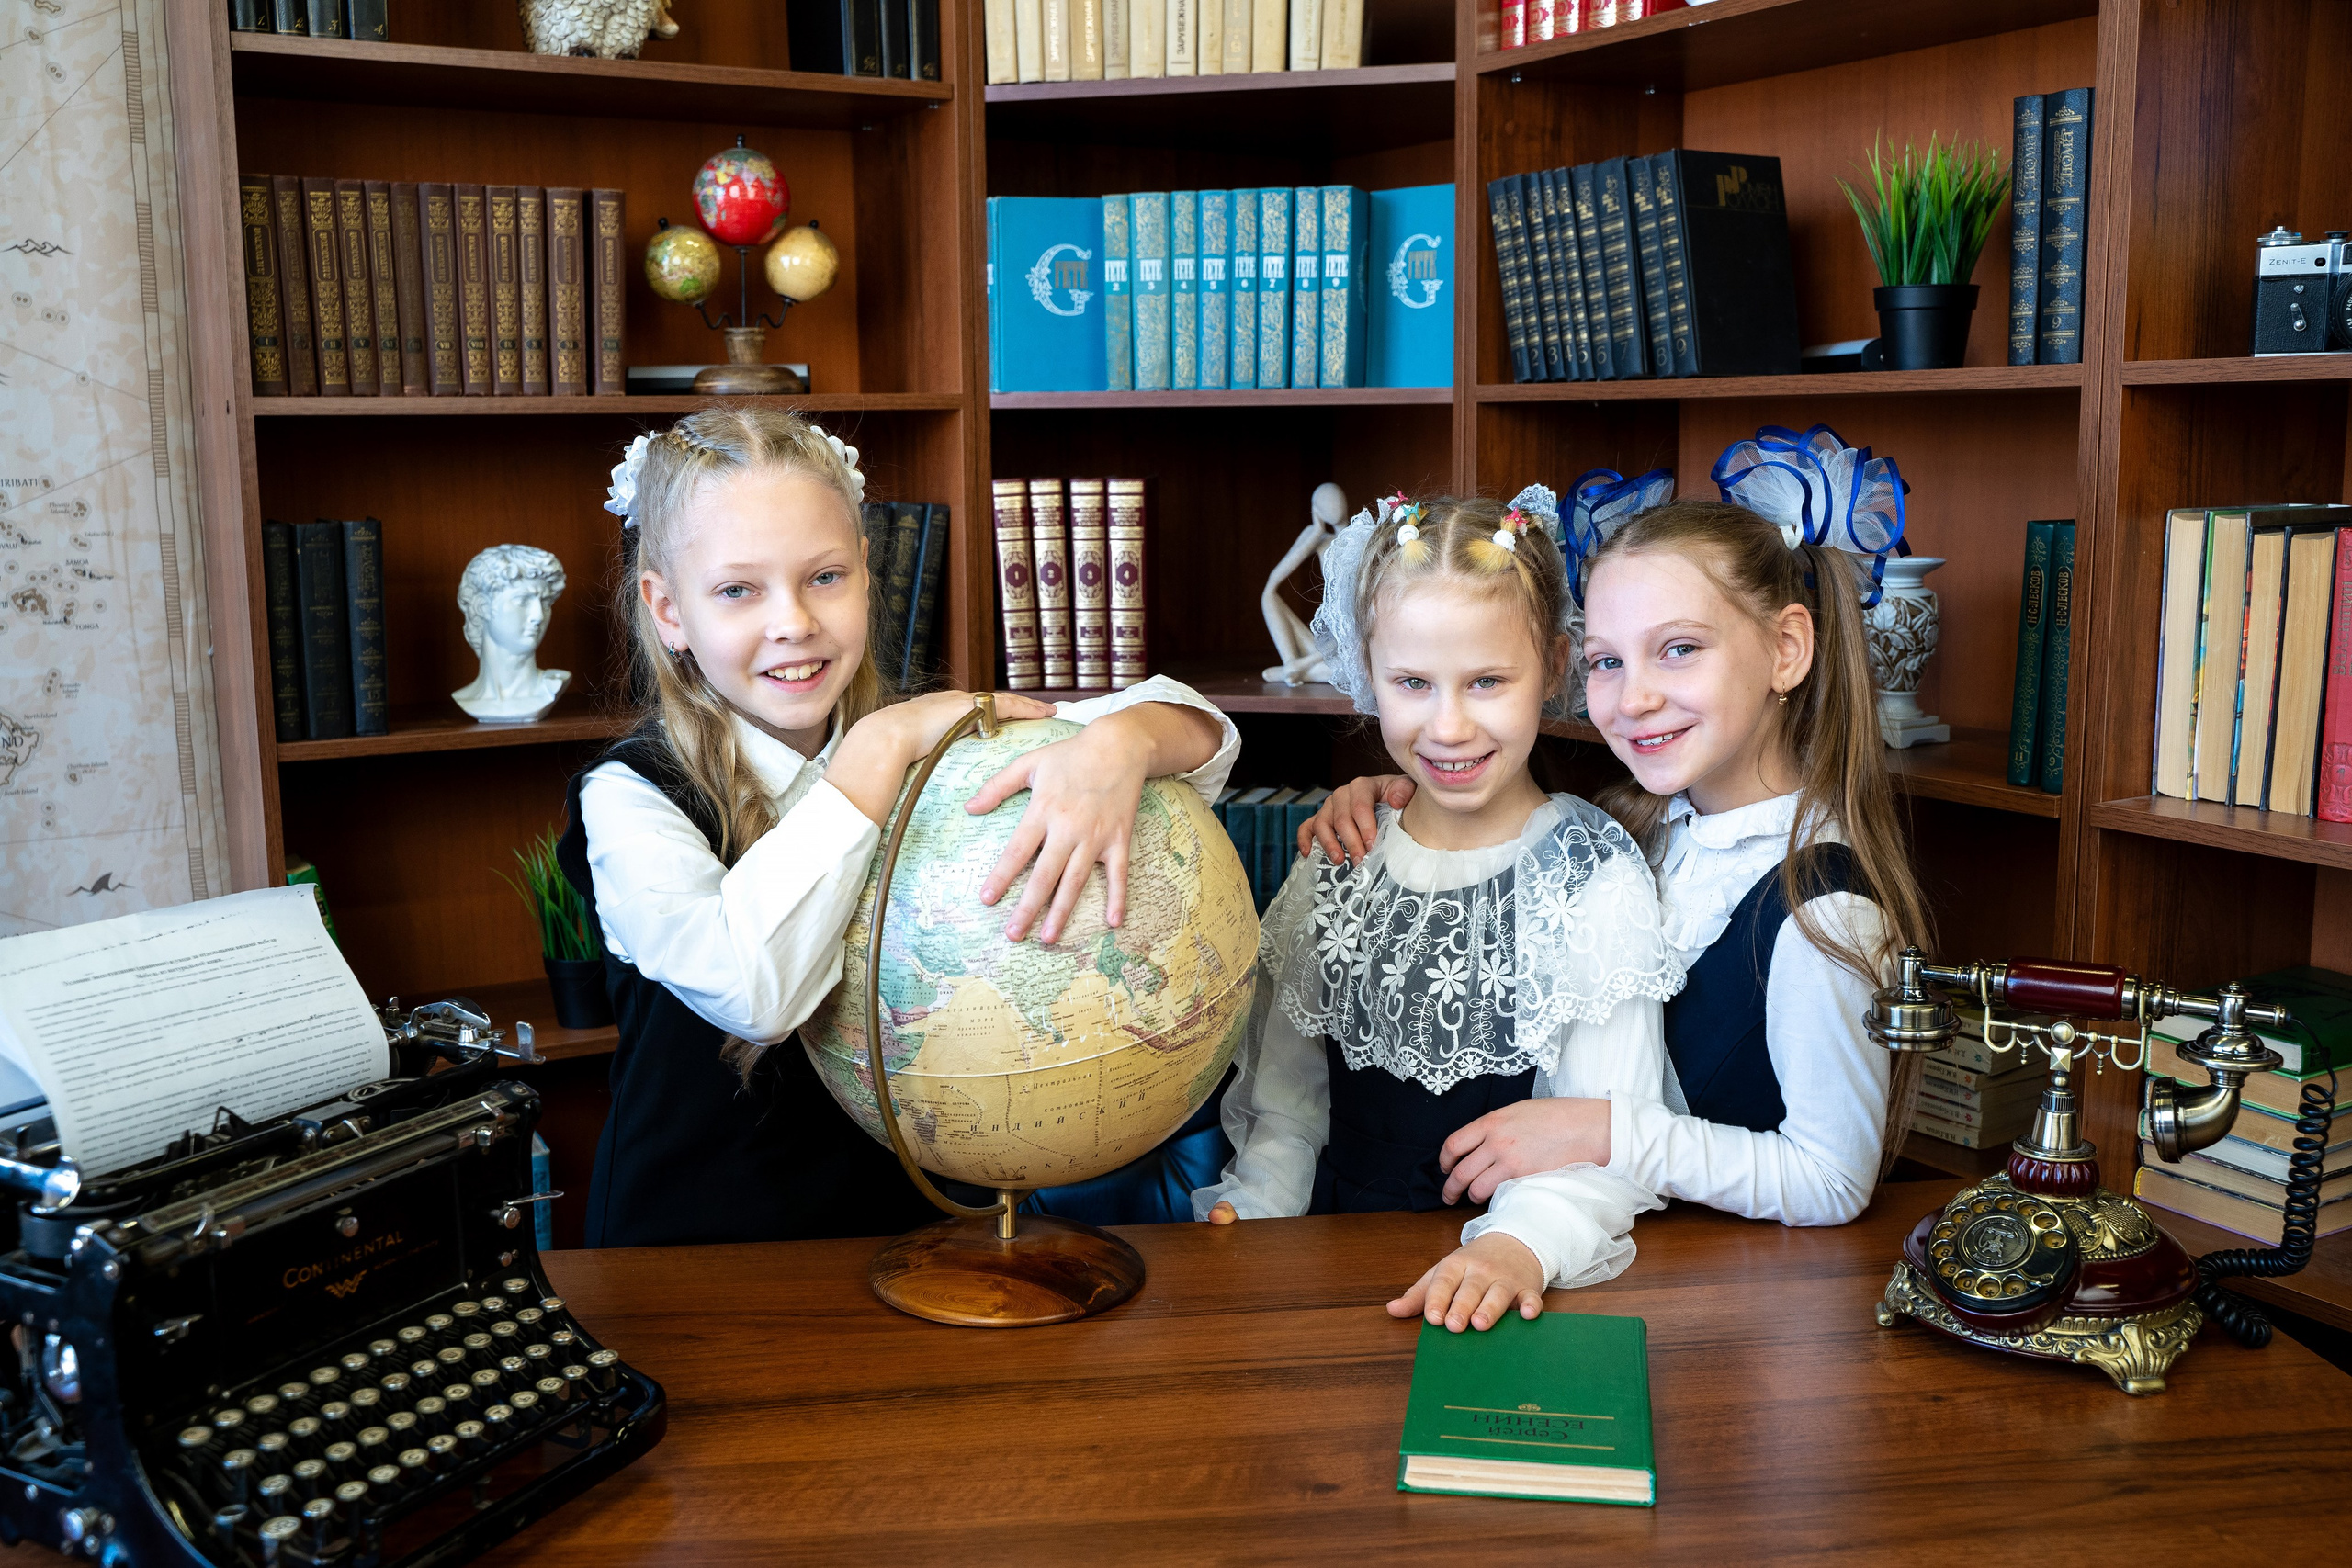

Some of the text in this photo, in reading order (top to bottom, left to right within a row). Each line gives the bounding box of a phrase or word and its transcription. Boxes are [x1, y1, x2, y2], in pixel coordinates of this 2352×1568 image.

[2016, 320, 2026, 333] 2
[2052, 316, 2062, 329] 9
[1548, 347, 1558, 363] 3
[1564, 346, 1573, 362] 4
[1578, 348, 1588, 363] 5
[1596, 344, 1607, 364] 6
[1620, 342, 1628, 360] 7
[1677, 339, 1687, 356] 9
[1515, 351, 1521, 363] 1
[1531, 349, 1539, 363] 2
[1657, 346, 1667, 366] 8
[2048, 756, 2056, 766] 9
[1033, 1073, 1092, 1089] Центральная
[970, 1092, 1146, 1132] ИНДИЙСКИЙ
[1044, 1098, 1096, 1113] котловина
[1019, 1145, 1123, 1170] ОКЕАН
[1473, 1414, 1584, 1430] ЕСЕНИН
[1488, 1426, 1568, 1440] Сергей
